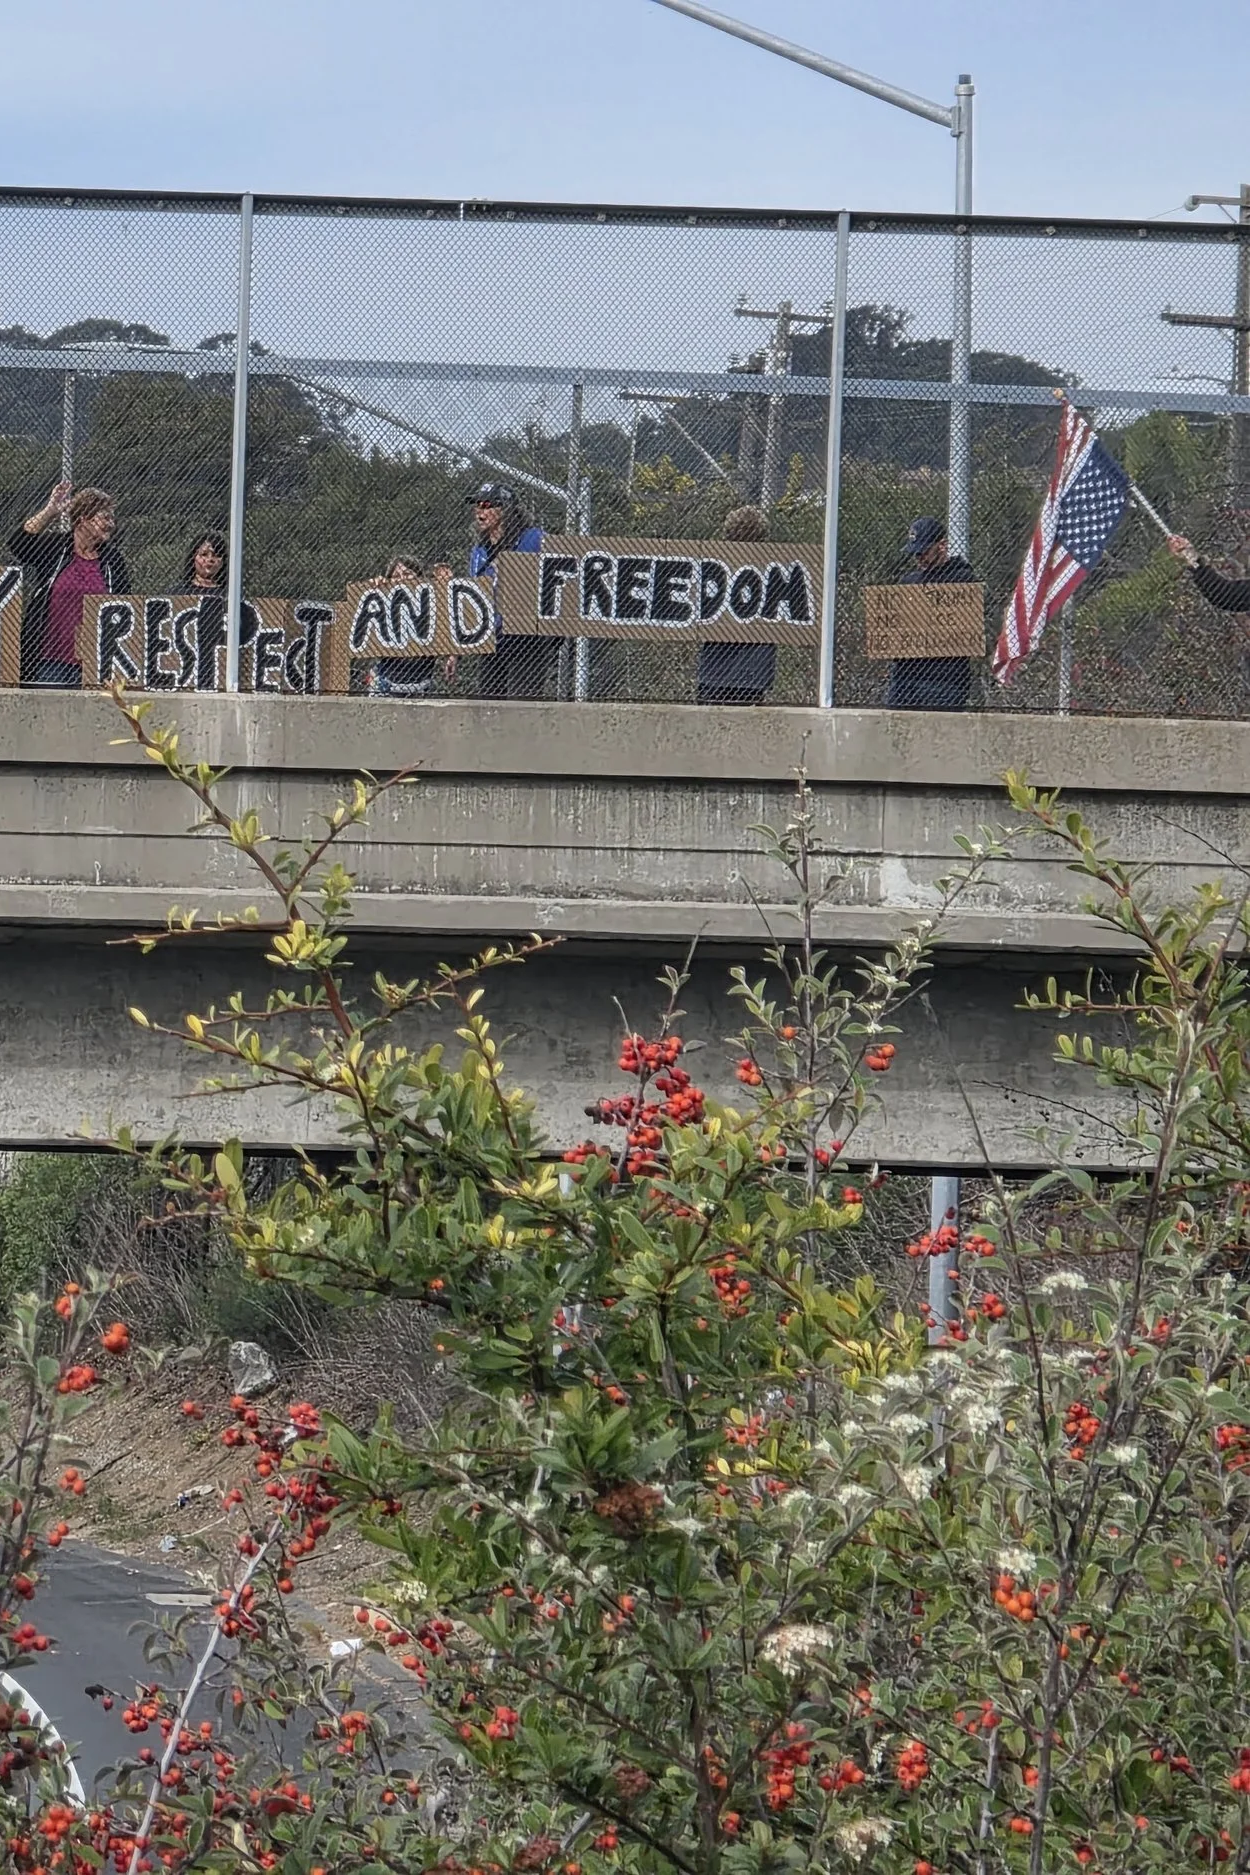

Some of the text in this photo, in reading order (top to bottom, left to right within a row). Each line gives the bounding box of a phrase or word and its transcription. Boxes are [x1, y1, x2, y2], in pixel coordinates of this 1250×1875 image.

[351, 578, 495, 653] AND
[538, 551, 815, 627] FREEDOM
[97, 595, 335, 694] RESPECT
